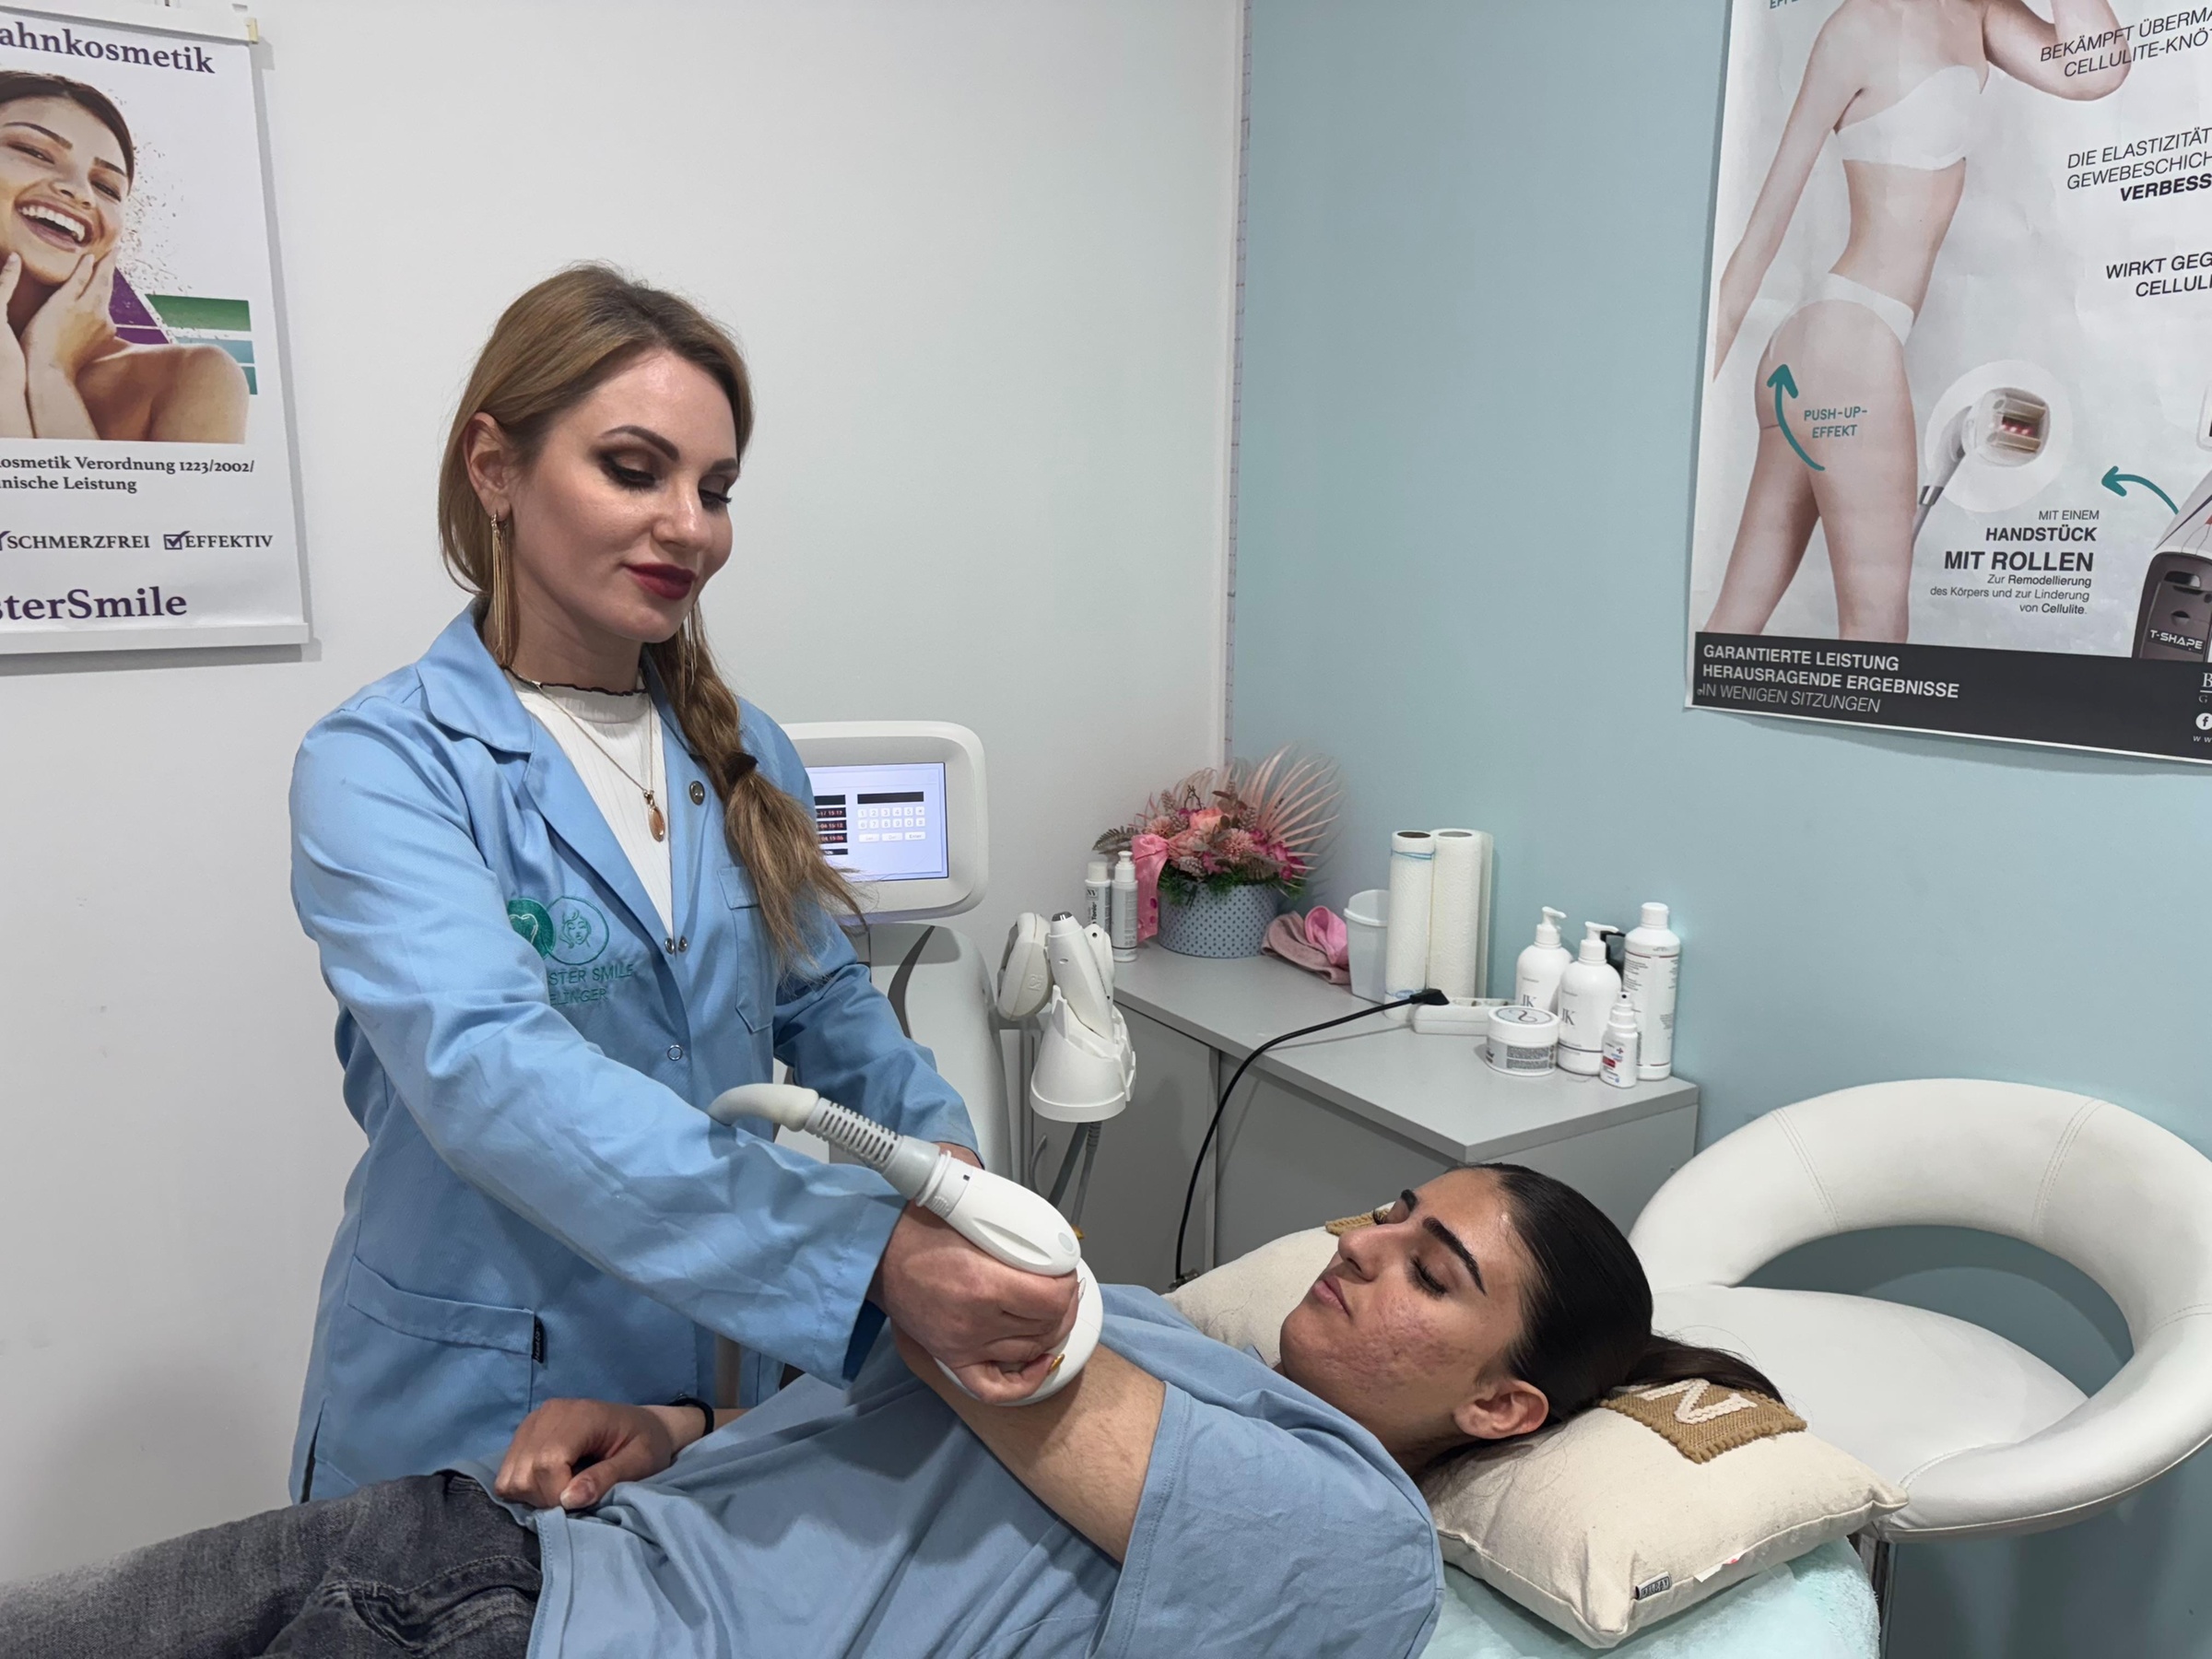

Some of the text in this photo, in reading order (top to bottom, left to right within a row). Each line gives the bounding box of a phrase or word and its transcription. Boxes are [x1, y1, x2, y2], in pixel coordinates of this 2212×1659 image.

[0, 22, 216, 74] ahnkosmetik
[2040, 25, 2136, 62] BEKÄMPFT
[2065, 27, 2212, 77] CELLULITE-KNÖ
[2067, 126, 2212, 169] DIE ELASTIZITÄT
[2120, 173, 2212, 202] VERBESS
[2106, 252, 2212, 279] WIRKT GEG
[1804, 406, 1867, 421] PUSH-UP-
[1812, 424, 1858, 439] EFFEKT
[0, 455, 254, 475] osmetik Verordnung 1223/2002/
[0, 476, 137, 494] nische Leistung
[2038, 510, 2100, 521] MIT EINEM
[6, 534, 274, 549] SCHMERZFREI EFFEKTIV
[1985, 524, 2098, 542] HANDSTÜCK
[1944, 551, 2094, 571] MIT ROLLEN
[1987, 574, 2092, 589] Zur Remodellierung
[1930, 586, 2089, 603] des Körpers und zur Linderung
[2019, 603, 2088, 615] von Cellulite.
[2149, 629, 2204, 650] T-SHAPE
[1703, 645, 1900, 671] GARANTIERTE LEISTUNG
[1702, 665, 1960, 699] HERAUSRAGENDE ERGEBNISSE
[1701, 683, 1881, 713] IN WENIGEN SITZUNGEN
[592, 964, 633, 982] SMILE
